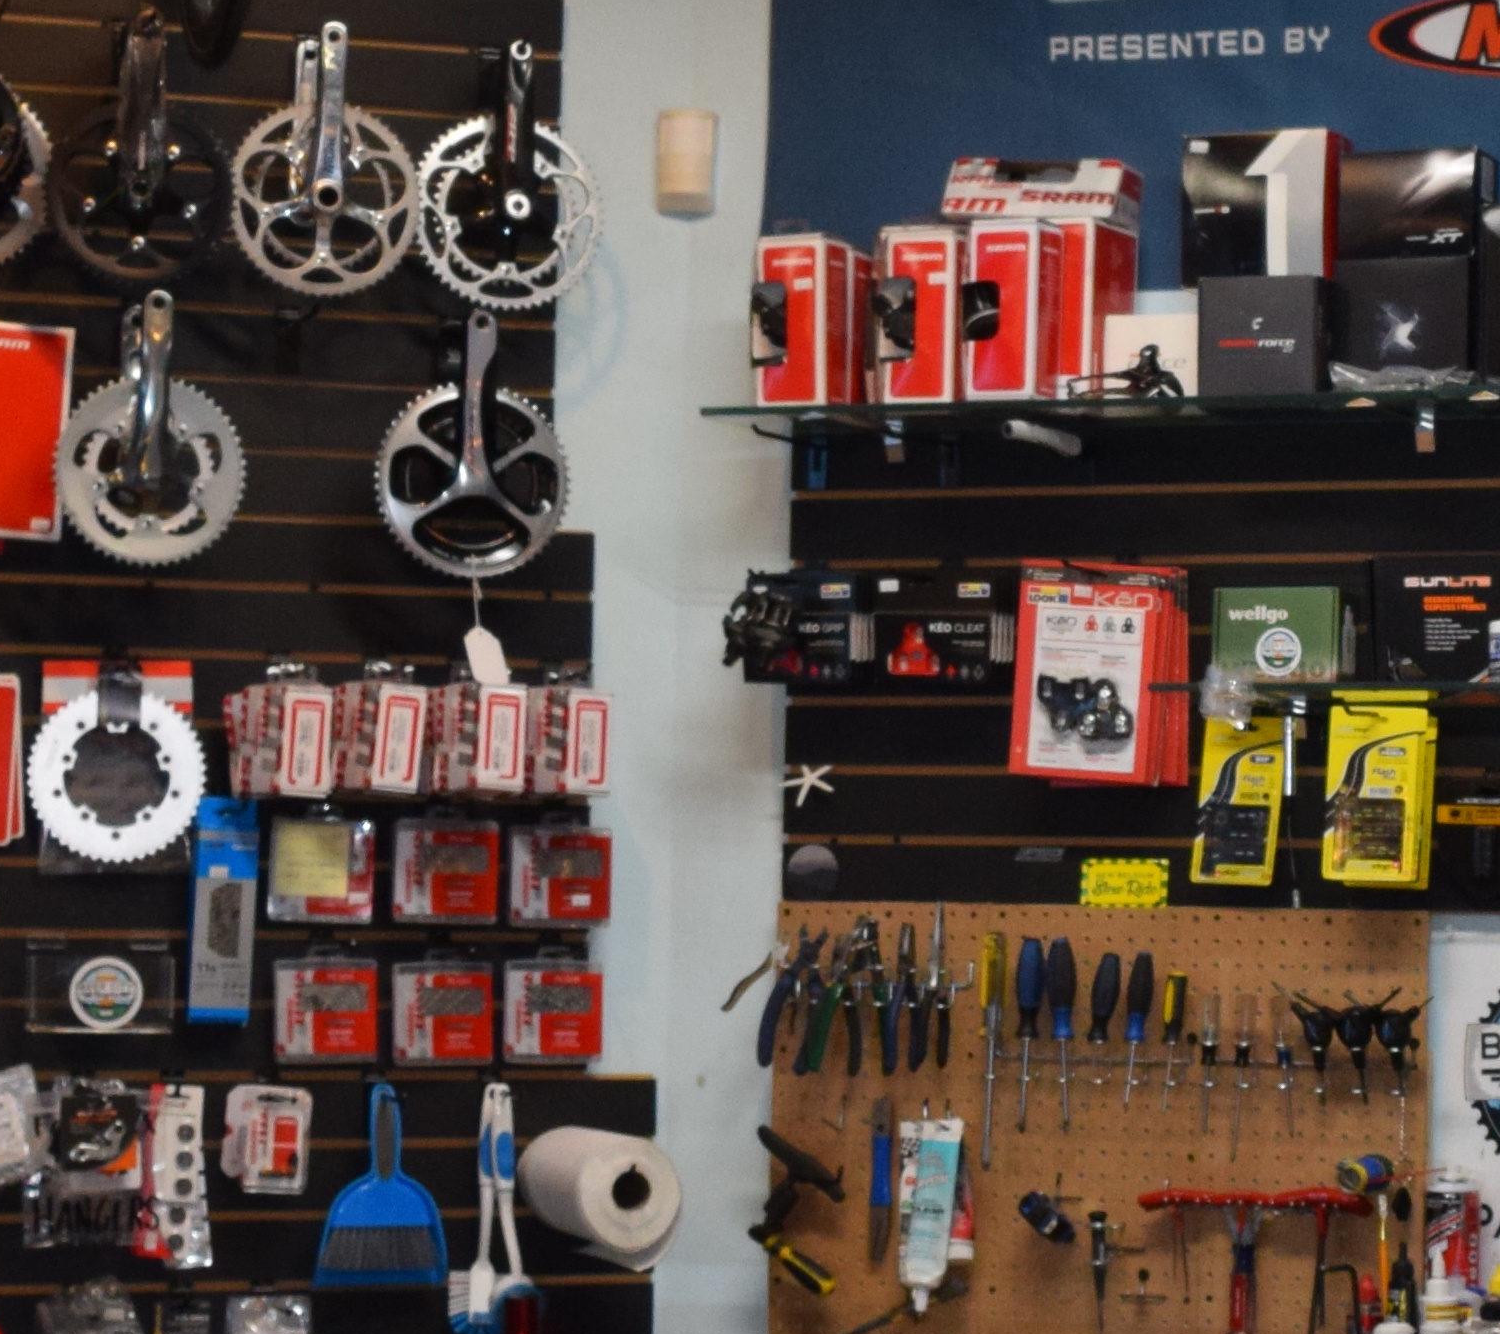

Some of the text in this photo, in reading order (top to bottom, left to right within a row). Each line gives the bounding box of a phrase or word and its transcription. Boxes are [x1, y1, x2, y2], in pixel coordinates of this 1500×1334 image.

[1049, 25, 1330, 62] PRESENTED BY
[1021, 190, 1116, 205] SRAM
[1403, 575, 1493, 589] SUNLITE
[1029, 591, 1057, 604] LOOK
[1228, 607, 1289, 625] wellgo
[823, 621, 846, 634] GRIP
[953, 622, 986, 634] CLEAT
